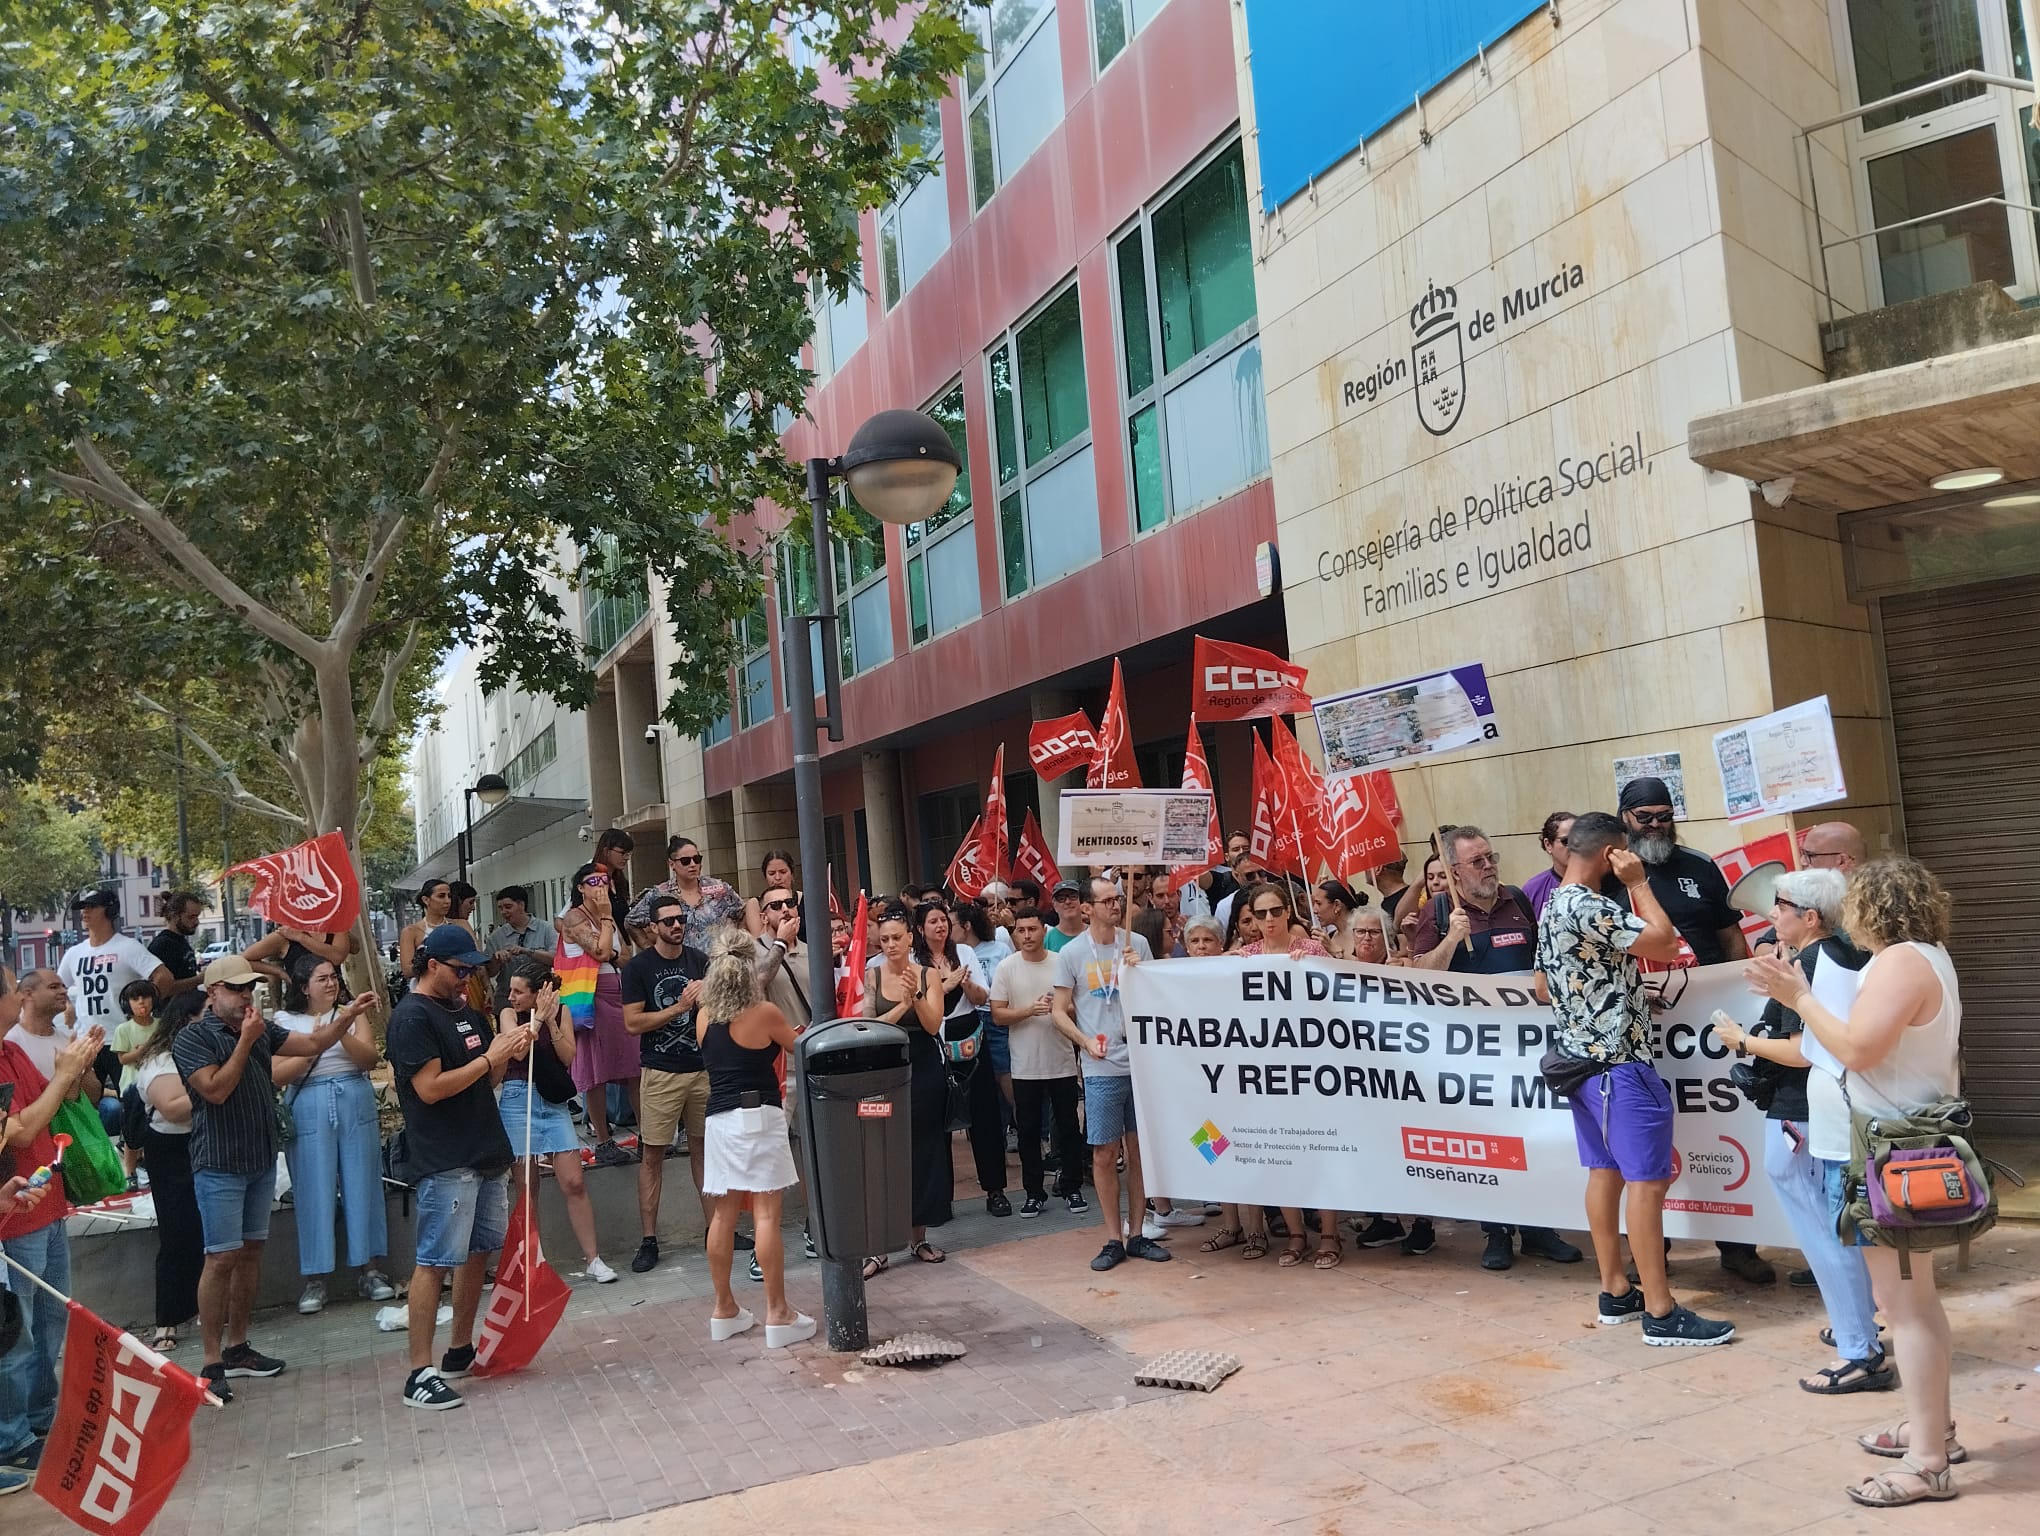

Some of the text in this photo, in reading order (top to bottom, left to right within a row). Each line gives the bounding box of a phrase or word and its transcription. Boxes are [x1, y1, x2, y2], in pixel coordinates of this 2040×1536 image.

[1344, 264, 1584, 407] Región de Murcia
[1318, 519, 1421, 581] Consejería
[1429, 506, 1457, 543] de
[1465, 476, 1553, 531] Política
[1559, 431, 1653, 497] Social,
[1363, 509, 1592, 616] Familias e Igualdad
[1209, 695, 1248, 708] Región
[1252, 694, 1265, 705] de
[1077, 836, 1138, 846] MENTIROSOS
[1493, 933, 1523, 944] CCOO
[83, 974, 109, 995] DO
[1242, 971, 1292, 1001] EN
[1306, 971, 1492, 1007] DEFENSA
[87, 996, 110, 1016] IT.
[1132, 1016, 1430, 1054] TRABAJADORES
[1446, 1024, 1501, 1056] DE
[1201, 1064, 1225, 1094] Y
[1238, 1064, 1426, 1103] REFORMA
[1438, 1072, 1494, 1106] DE
[1232, 1126, 1267, 1134] Asociación
[1279, 1128, 1325, 1137] Trabajadores
[1233, 1140, 1252, 1149] Sector
[1254, 1141, 1263, 1149] de
[1264, 1142, 1300, 1151] Protección
[1309, 1144, 1339, 1152] Reforma
[1341, 1144, 1350, 1152] de
[1408, 1134, 1486, 1160] CCOO
[1235, 1155, 1292, 1166] Región de Murcia
[1688, 1152, 1734, 1163] Servicios
[1406, 1165, 1499, 1186] enseñanza
[1690, 1163, 1732, 1175] Públicos
[1663, 1200, 1736, 1213] gión de Murcia
[85, 1390, 103, 1414] de
[61, 1420, 97, 1491] Murcia
